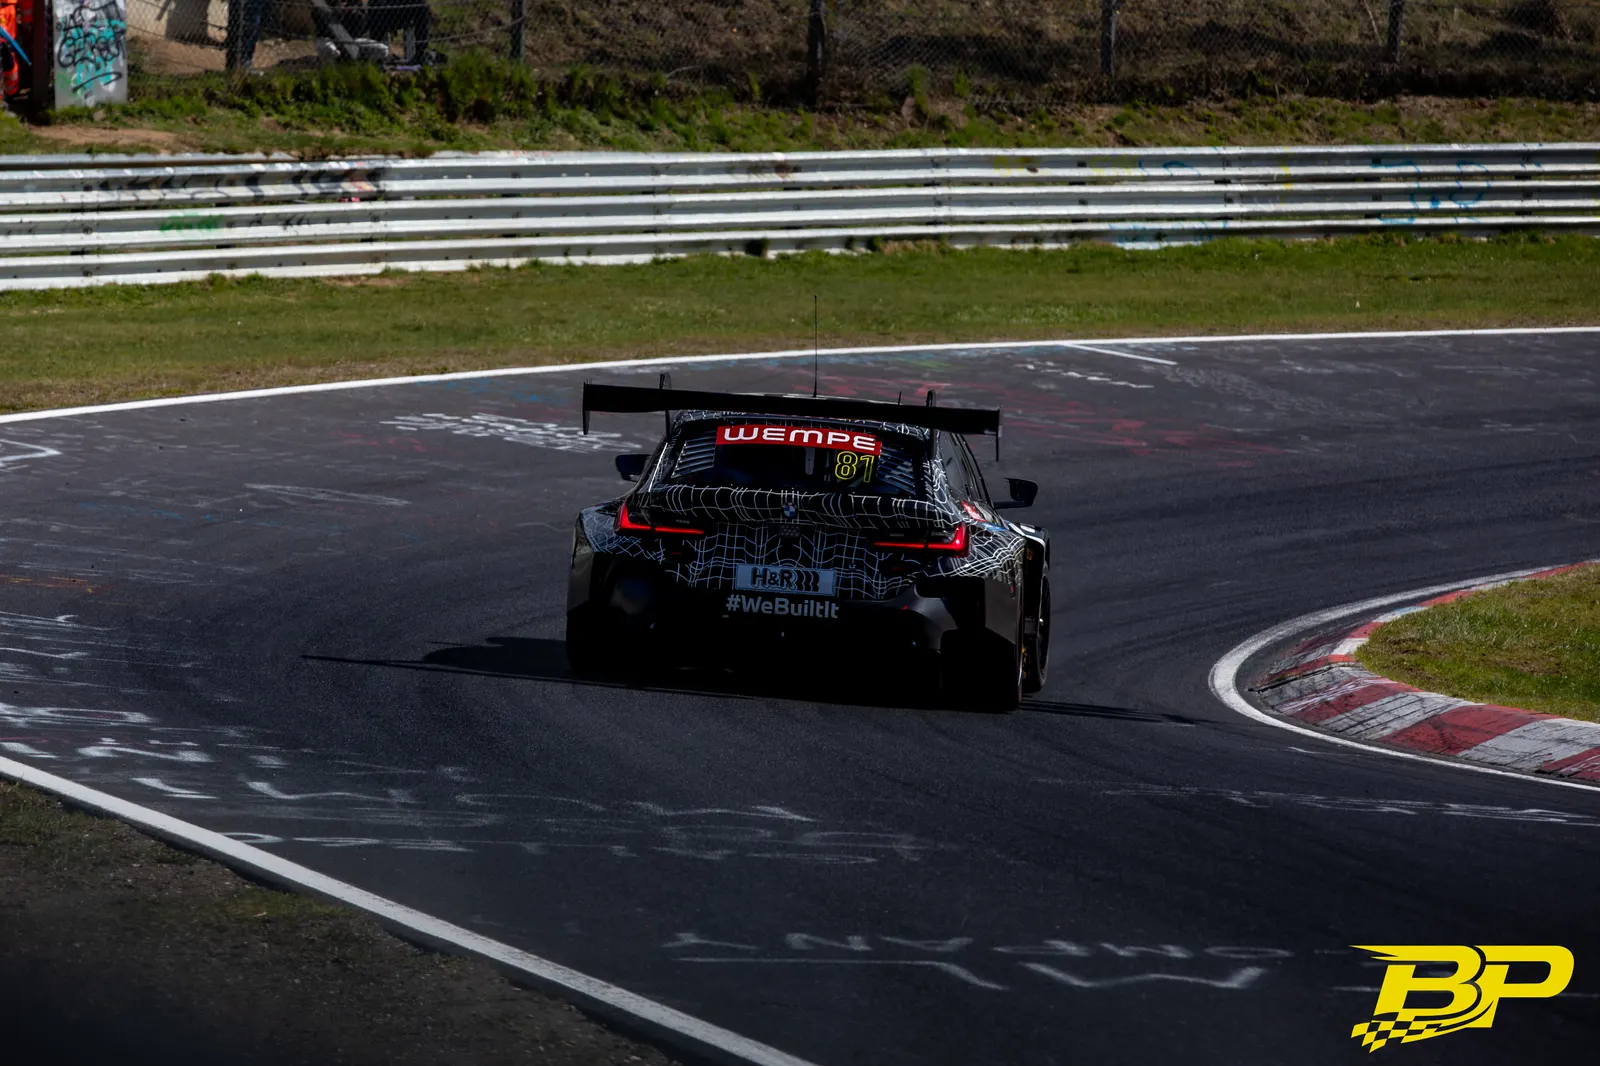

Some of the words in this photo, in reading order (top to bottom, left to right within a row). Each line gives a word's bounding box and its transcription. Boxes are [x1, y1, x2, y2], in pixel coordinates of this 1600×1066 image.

[723, 427, 876, 451] WEMPE
[835, 451, 875, 483] 81
[751, 567, 806, 590] H&R
[726, 593, 840, 618] #WeBuiltIt
